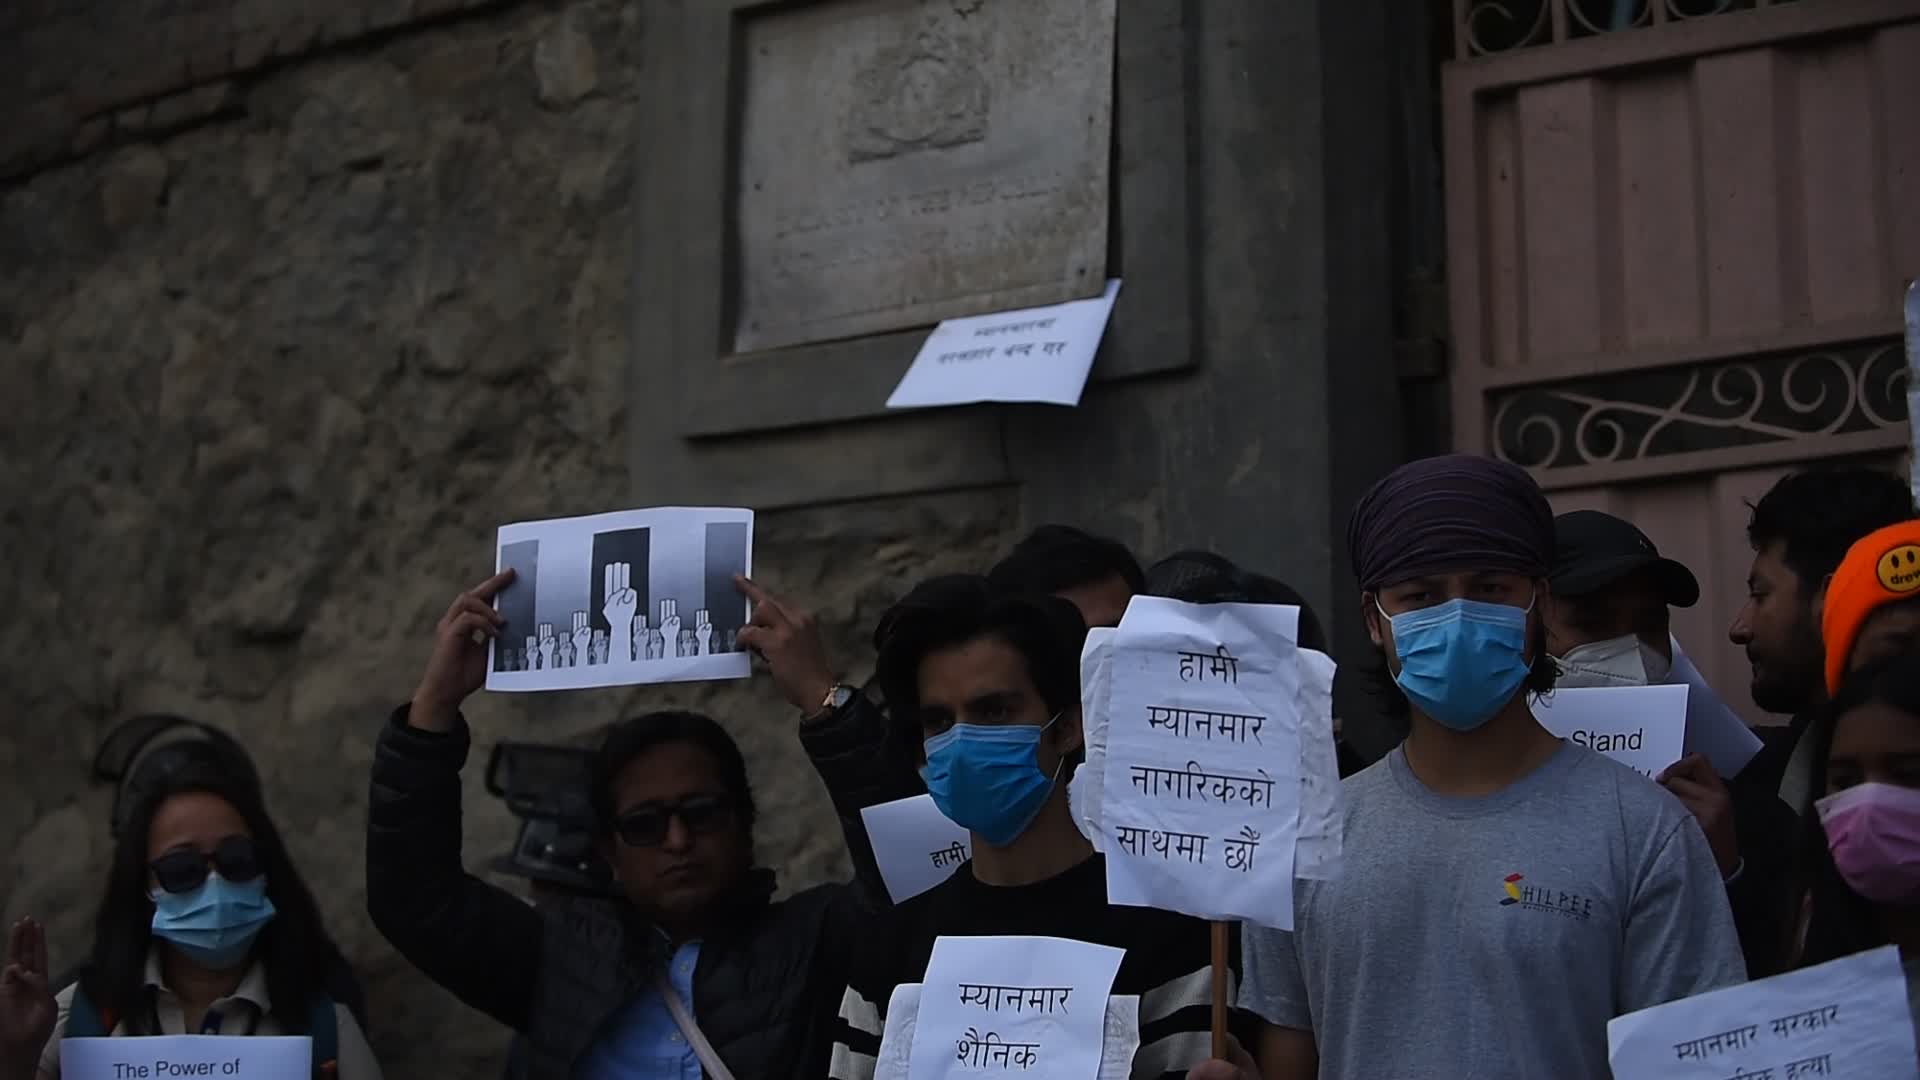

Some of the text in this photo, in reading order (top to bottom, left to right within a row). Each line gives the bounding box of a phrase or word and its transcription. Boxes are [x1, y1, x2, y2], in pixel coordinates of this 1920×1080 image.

[1177, 645, 1239, 685] हामी
[1146, 706, 1267, 746] म्यानमार
[1572, 728, 1643, 751] Stand
[1130, 760, 1276, 808] नागरिकको
[929, 841, 967, 868] हामी
[1115, 826, 1210, 864] साथमा
[958, 984, 1073, 1014] म्यानमार
[1673, 1004, 1840, 1060] म्यानमार सरकार
[113, 1058, 240, 1079] The Power of
